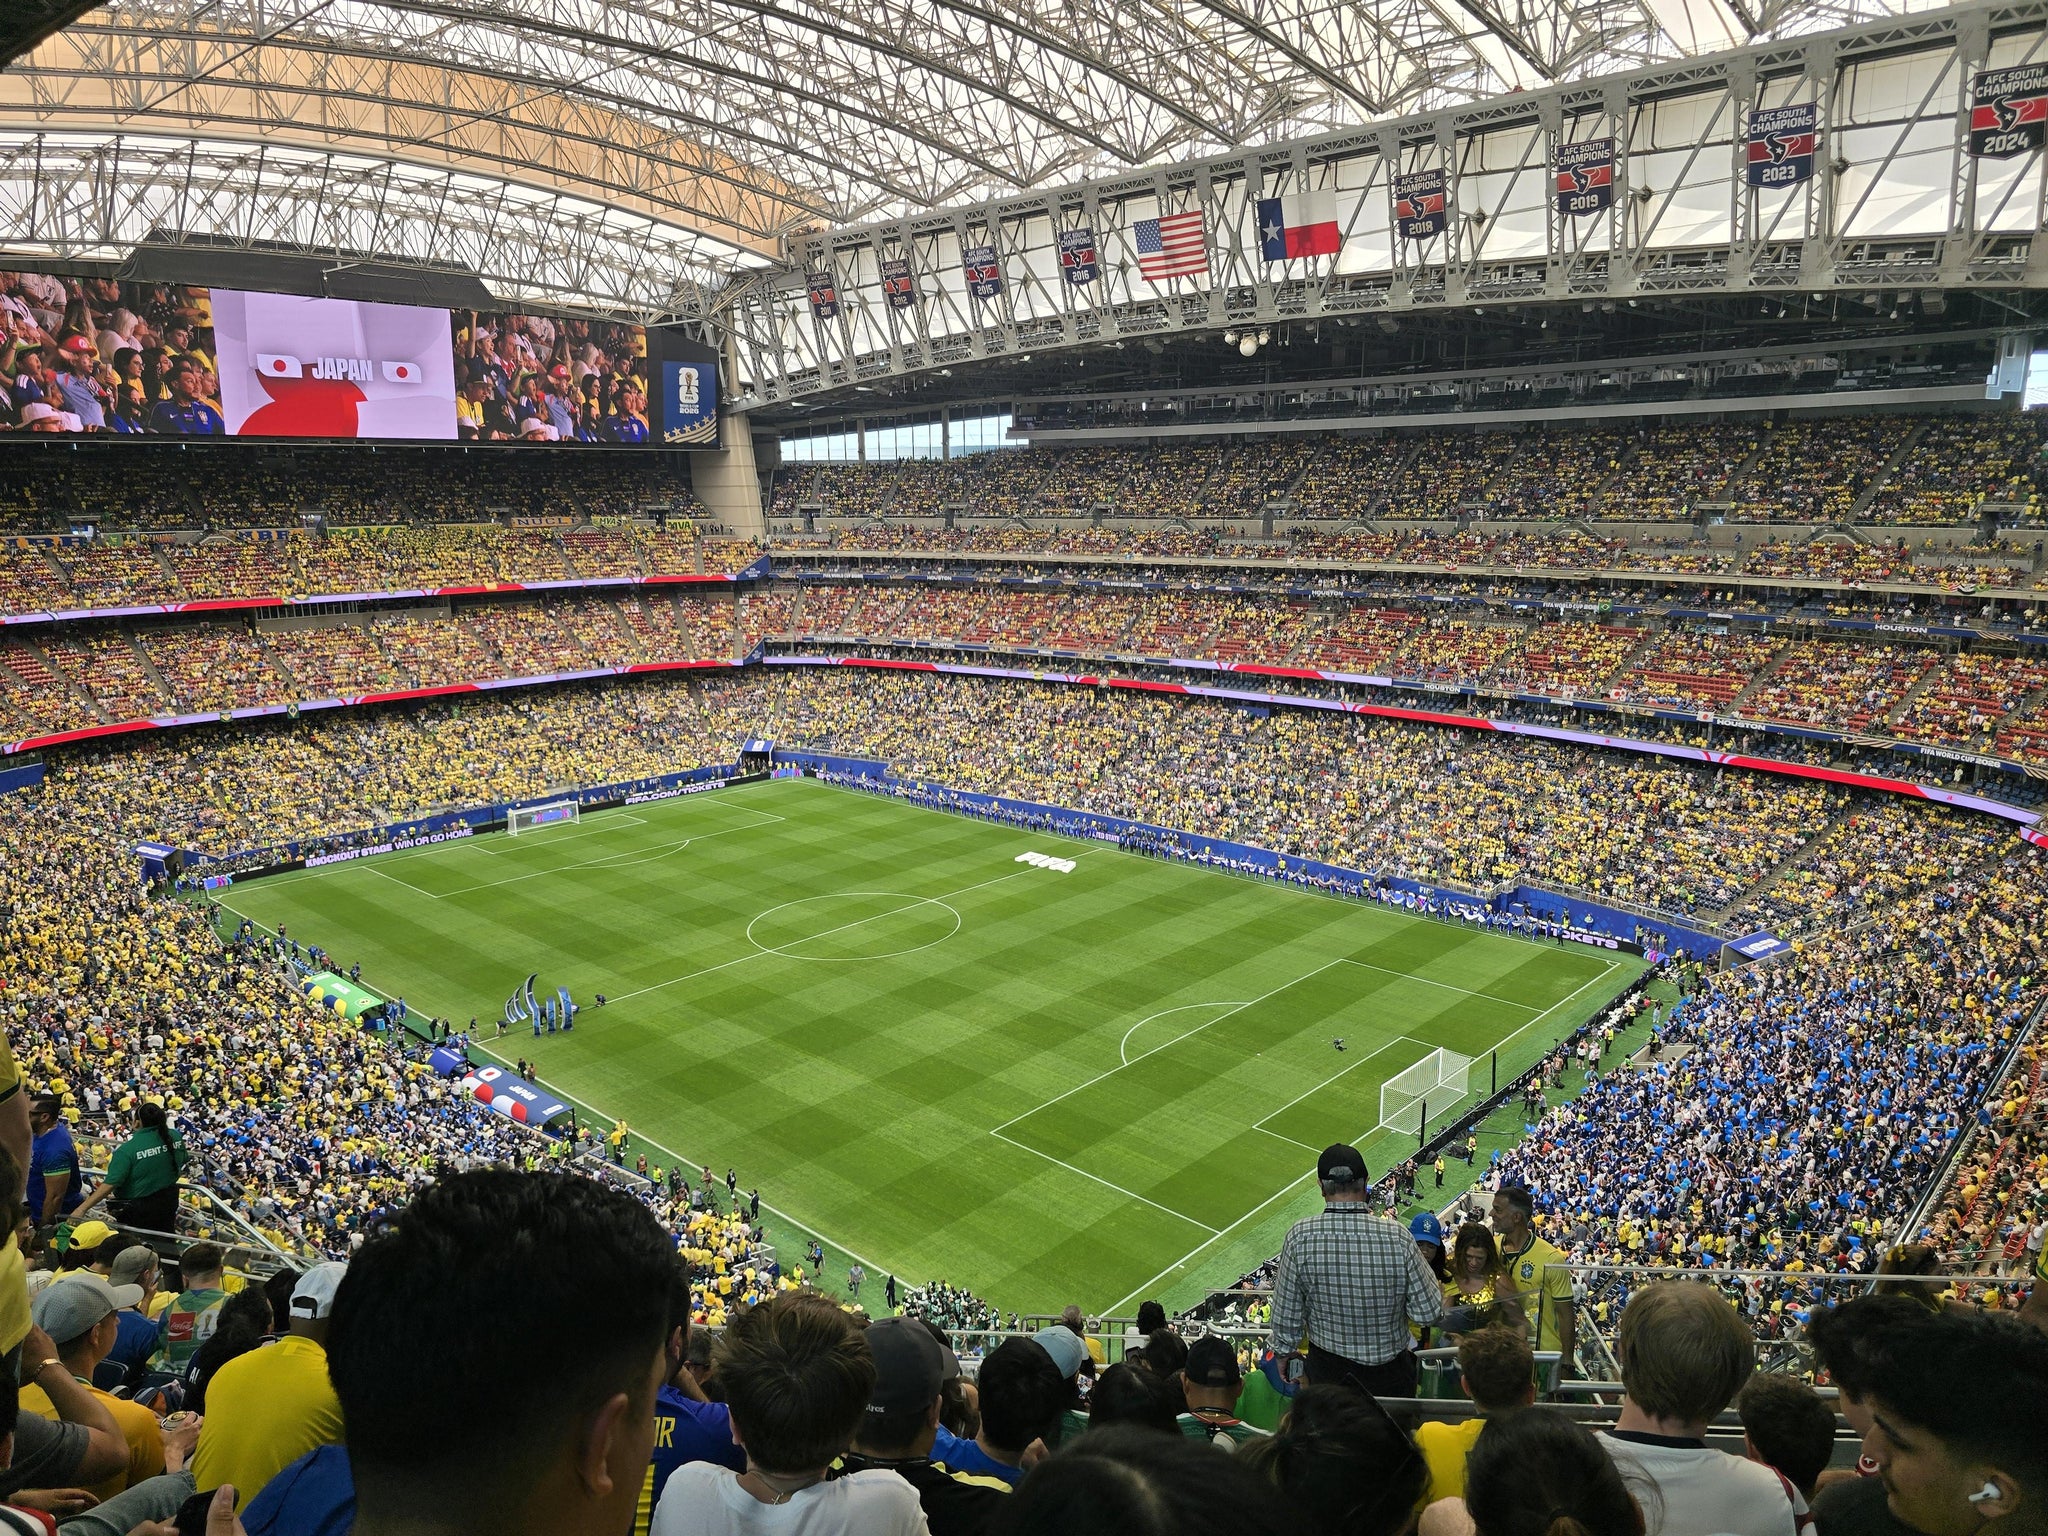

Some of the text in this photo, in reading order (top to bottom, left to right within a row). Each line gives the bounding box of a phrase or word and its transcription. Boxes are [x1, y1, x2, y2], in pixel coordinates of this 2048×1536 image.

[1985, 67, 2044, 86] AFC SOUTH
[1975, 76, 2048, 98] CHAMPIONS
[1757, 107, 1807, 123] AFC SOUTH
[1750, 115, 1813, 134] CHAMPIONS
[1564, 141, 1605, 156] AFC SOUTH
[1983, 131, 2029, 154] 2024
[1558, 149, 1610, 166] CHAMPIONS
[1401, 172, 1436, 186] AFC SOUTH
[1762, 165, 1796, 183] 2023
[1396, 179, 1441, 194] CHAMPIONS
[1569, 194, 1599, 211] 2019
[1408, 221, 1434, 235] 2018
[1060, 236, 1091, 248] CHAMPIONS
[1072, 270, 1090, 281] 2016
[977, 284, 994, 296] 2015
[893, 295, 908, 306] 2012
[312, 357, 374, 382] JAPAN
[1311, 589, 1344, 597] HOUSTON
[1874, 623, 1928, 634] HOUSTON
[1424, 683, 1461, 693] HOUSTON
[1716, 719, 1766, 731] HOUSTON
[1920, 747, 2001, 768] FIFA WORLD CUP 2026
[625, 781, 726, 805] FIFA.COM/TICKETS
[1105, 832, 1120, 843] STATE
[305, 827, 473, 868] KNOCKOUT STAGE WIN OR GO HOME
[1014, 851, 1077, 874] FIFA
[508, 1085, 538, 1101] JAPAN
[136, 1140, 182, 1160] EVENT SFF
